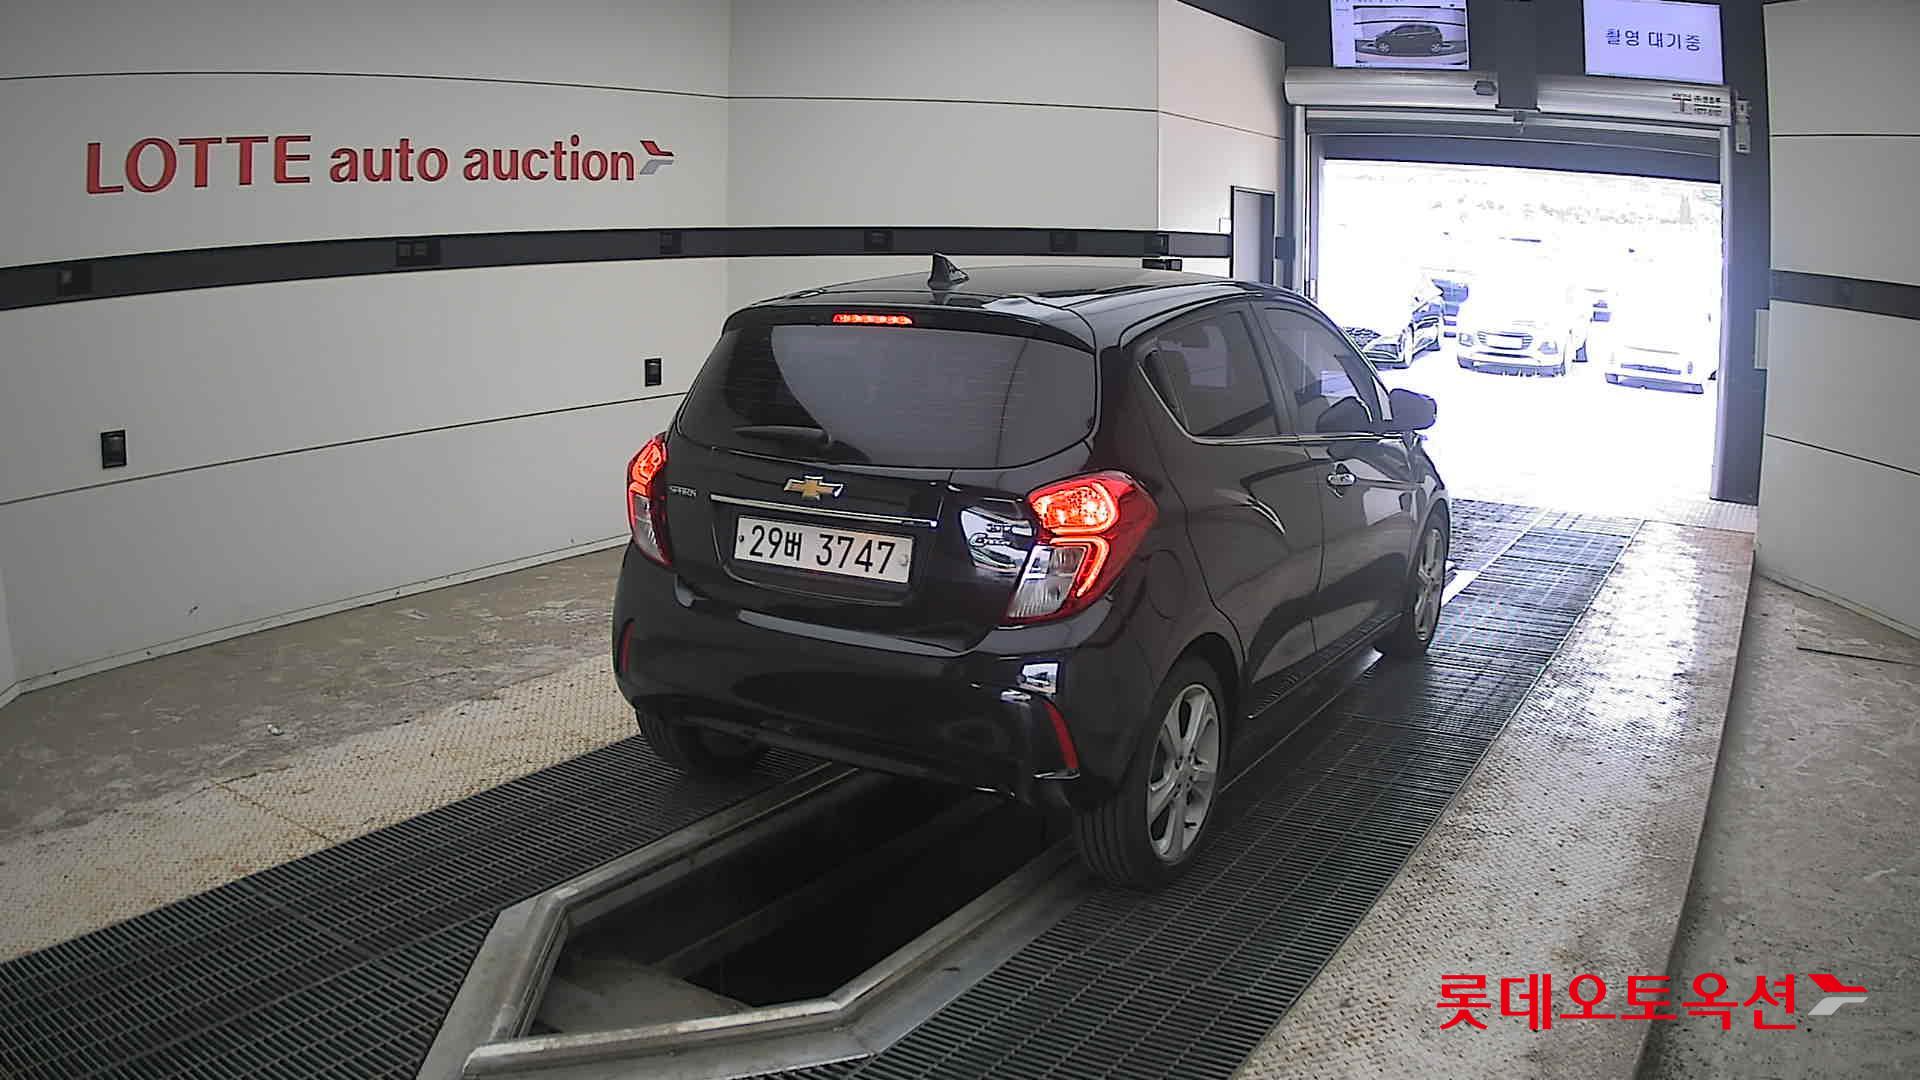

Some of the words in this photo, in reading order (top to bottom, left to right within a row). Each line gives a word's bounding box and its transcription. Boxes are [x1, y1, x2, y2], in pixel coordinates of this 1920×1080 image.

[1605, 28, 1640, 47] 촬영
[1648, 31, 1701, 51] 대기중
[86, 135, 312, 194] LOTTE
[329, 137, 449, 182] auto
[463, 134, 635, 181] auction
[749, 525, 803, 561] 29버
[815, 533, 896, 574] 3747
